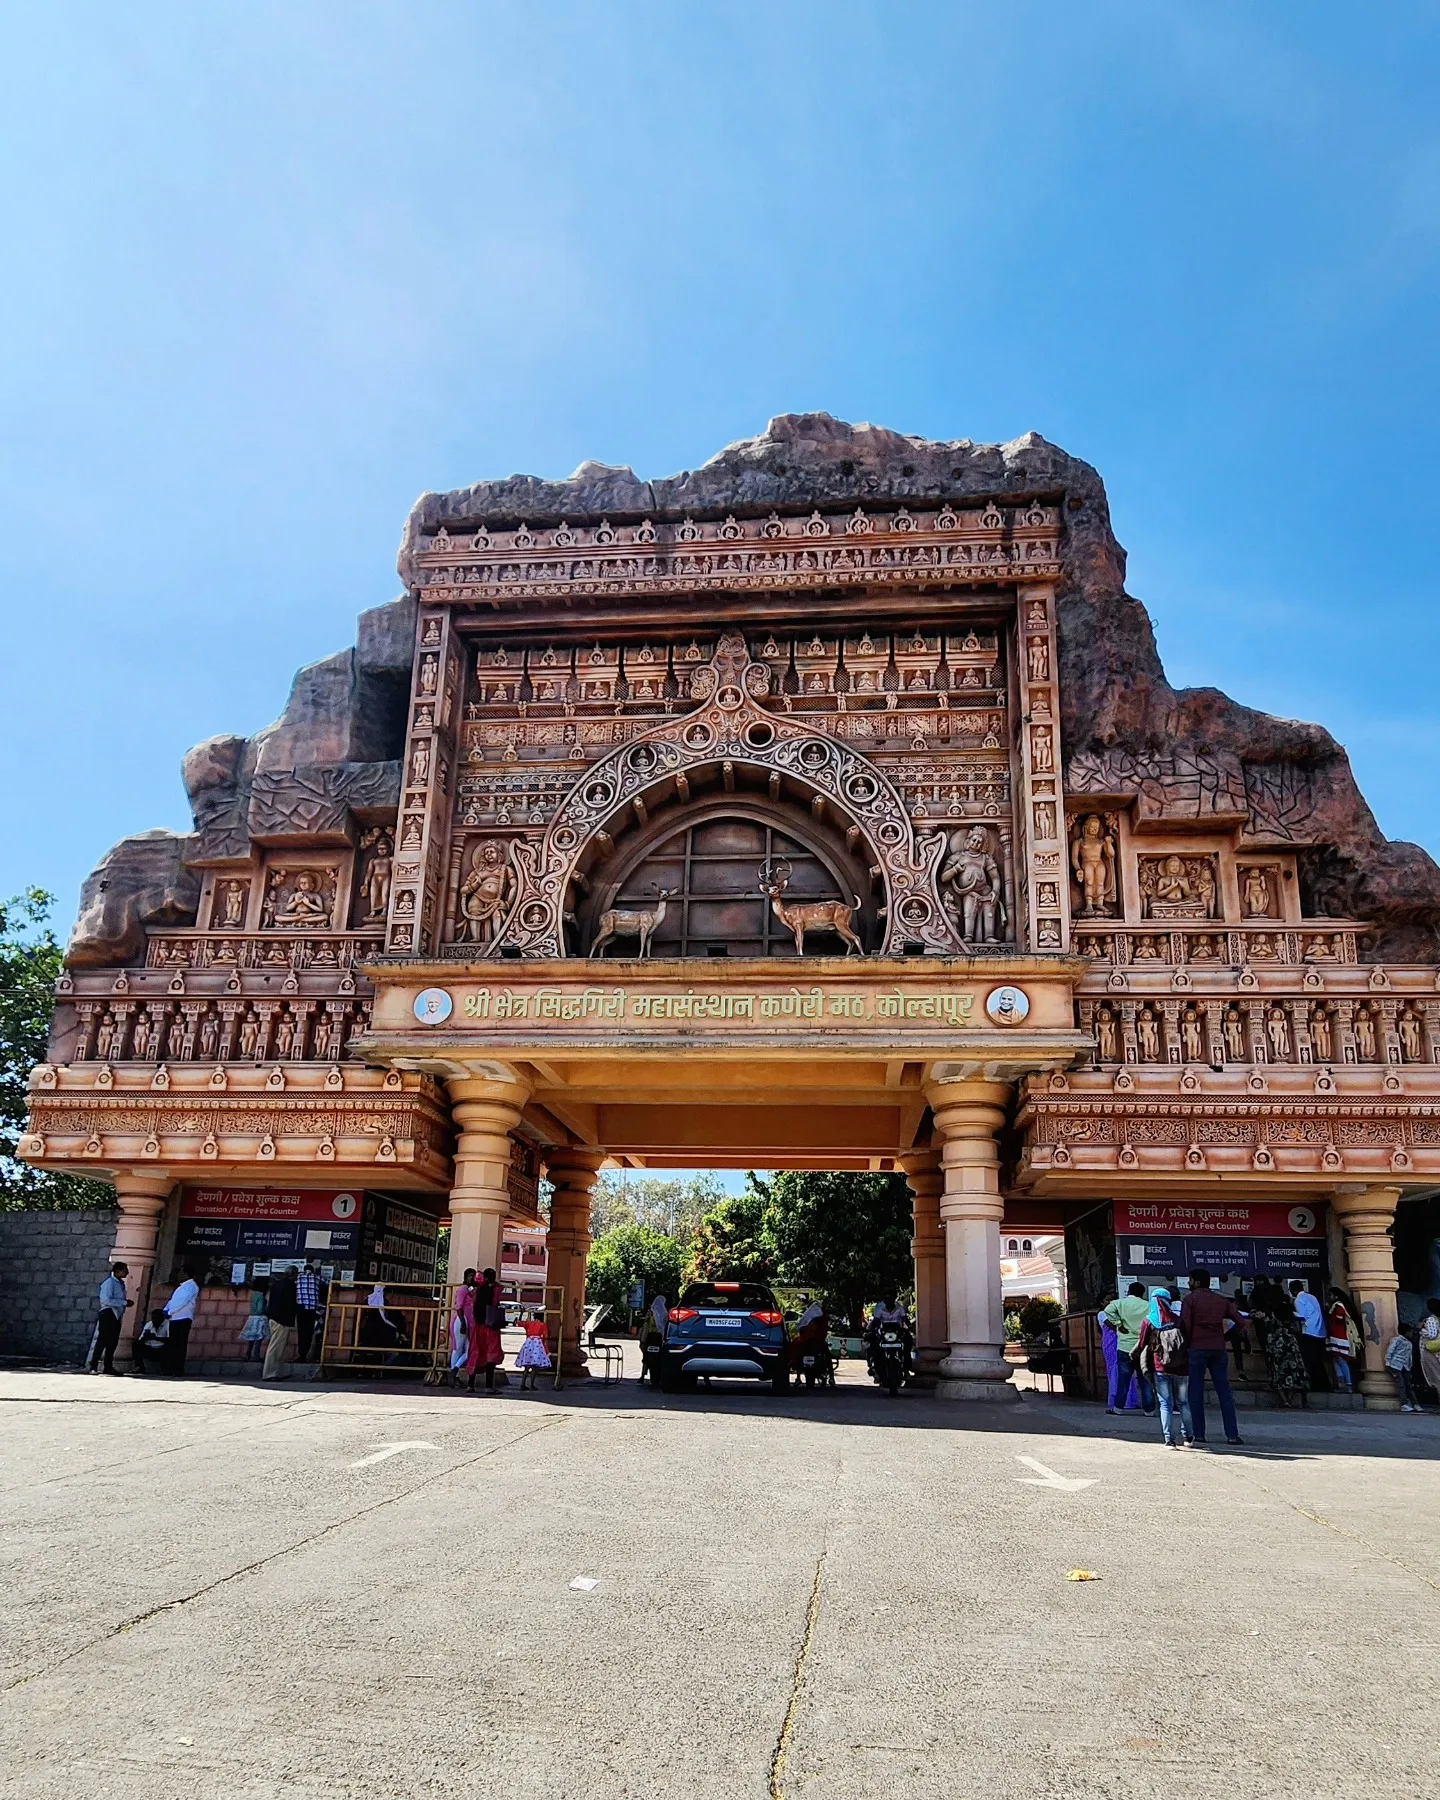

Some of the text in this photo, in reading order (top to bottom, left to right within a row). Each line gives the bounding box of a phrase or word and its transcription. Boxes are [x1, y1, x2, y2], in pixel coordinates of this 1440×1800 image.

[464, 988, 975, 1025] श्री क्षेत्र सिद्धगिरी महासंस्थान कणेरी मठ, कोल्हापूर
[197, 1190, 301, 1207] देणगी / प्रवेश शुल्क कक्ष
[195, 1205, 228, 1213] Donation
[234, 1206, 254, 1215] Entry
[255, 1207, 269, 1215] Fee
[269, 1207, 299, 1215] Counter
[340, 1198, 349, 1213] 1
[1128, 1204, 1250, 1222] देणगी / प्रवेश शुल्क कक्ष
[1128, 1221, 1167, 1230] Donation
[1174, 1222, 1199, 1231] Entry
[1199, 1222, 1216, 1230] Fee
[1216, 1222, 1251, 1231] Counter
[1296, 1213, 1308, 1229] 2
[201, 1239, 226, 1247] Payment
[1145, 1258, 1174, 1267] Payment
[1268, 1260, 1321, 1269] Online Payment
